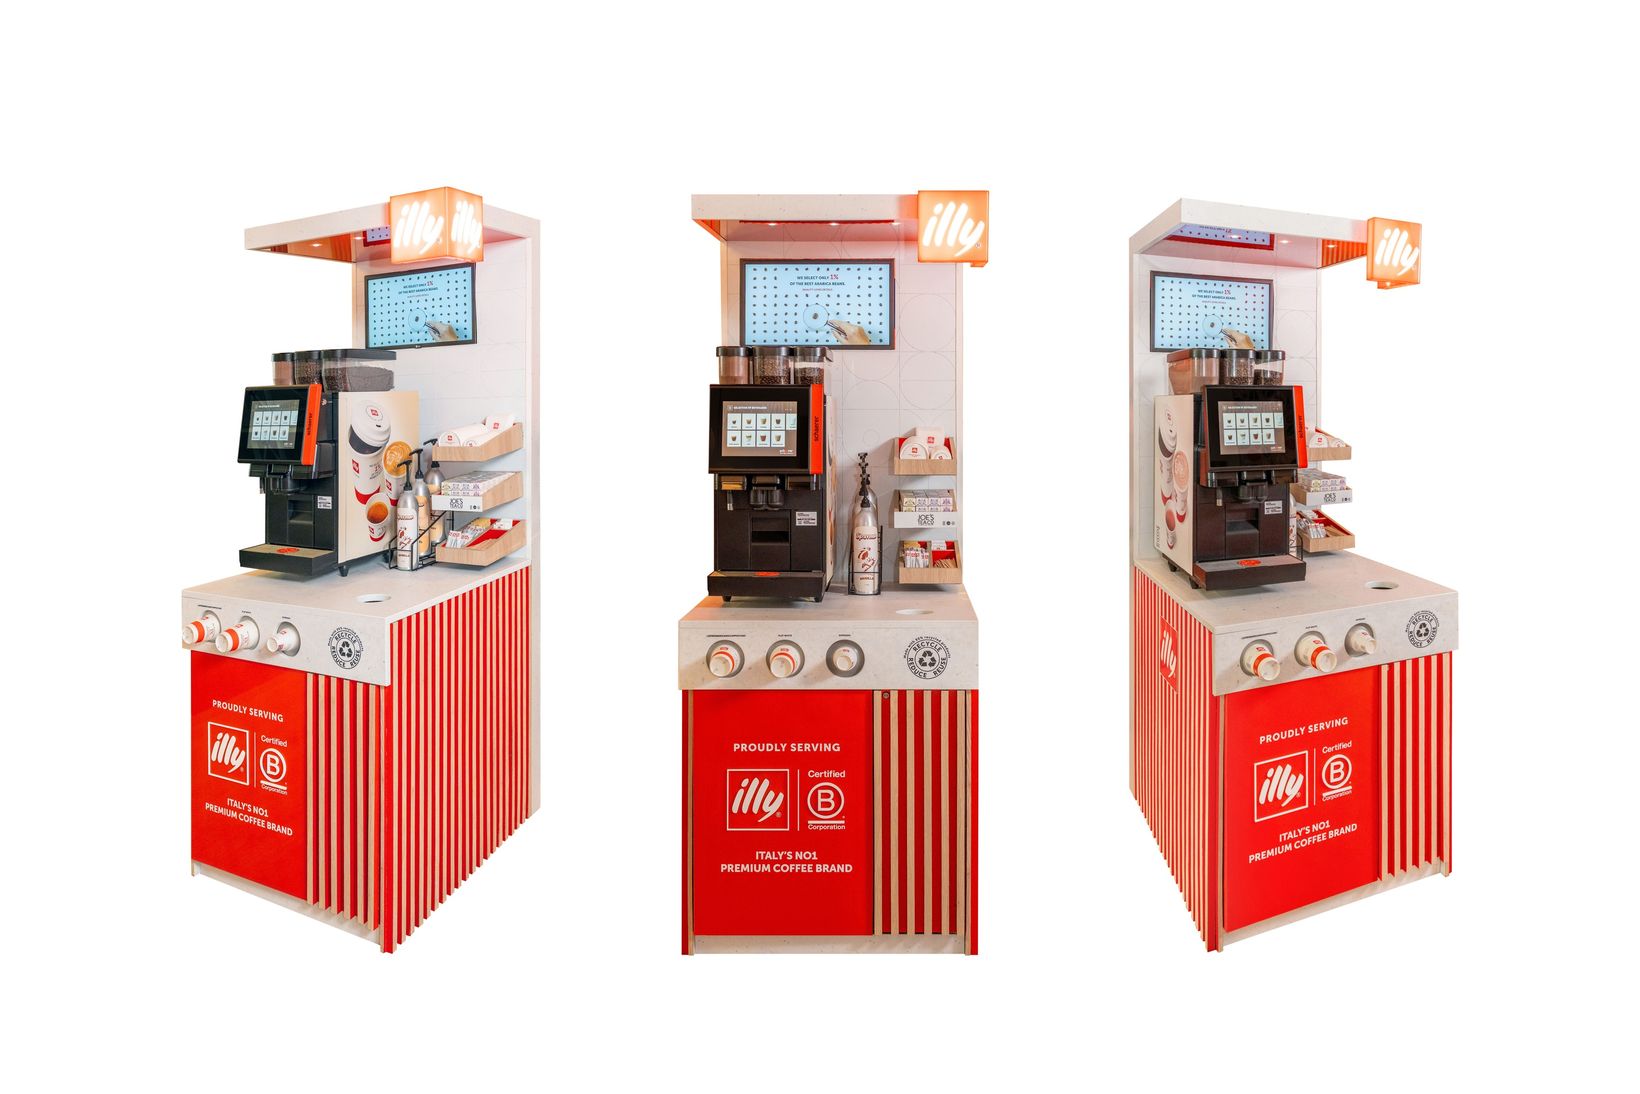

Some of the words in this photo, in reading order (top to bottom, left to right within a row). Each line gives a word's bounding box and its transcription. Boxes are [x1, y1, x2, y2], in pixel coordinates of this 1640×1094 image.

[394, 201, 444, 255] illy
[922, 201, 985, 257] illy
[1375, 227, 1420, 276] illy
[1412, 614, 1433, 625] RECYCLE
[335, 632, 356, 643] RECYCLE
[1410, 631, 1422, 646] REDUCE
[1427, 627, 1437, 643] REUSE
[332, 646, 345, 667] REDUCE
[913, 641, 942, 652] RECYCLE
[1161, 630, 1176, 678] illy
[350, 650, 360, 666] REUSE
[909, 657, 927, 678] REDUCE
[933, 657, 946, 676] REUSE
[212, 700, 247, 714] PROUDLY
[250, 708, 284, 722] SERVING
[261, 735, 287, 747] Certified
[1260, 727, 1305, 744] PROUDLY
[1308, 717, 1348, 734] SERVING
[212, 732, 245, 773] illy
[734, 743, 786, 752] PROUDLY
[791, 743, 840, 752] SERVING
[1322, 741, 1352, 754] Certified
[266, 754, 280, 776] B
[808, 770, 845, 778] Certified
[1330, 761, 1344, 783] B
[1259, 764, 1304, 807] illy
[228, 798, 251, 812] ITALY'S
[253, 806, 268, 817] NO1
[732, 777, 784, 822] illy
[817, 790, 835, 812] B
[205, 802, 237, 818] PREMIUM
[238, 813, 265, 829] COFFEE
[267, 821, 293, 836] BRAND
[1279, 826, 1310, 842] ITALY'S
[1312, 820, 1330, 832] NO1
[1249, 843, 1292, 864] PREMIUM
[1294, 834, 1330, 849] COFFEE
[1329, 823, 1357, 839] BRAND
[756, 851, 792, 860] ITALY'S
[796, 852, 817, 860] NO1
[721, 864, 770, 872] PREMIUM
[773, 864, 813, 872] COFFEE
[816, 864, 853, 872] BRAND
